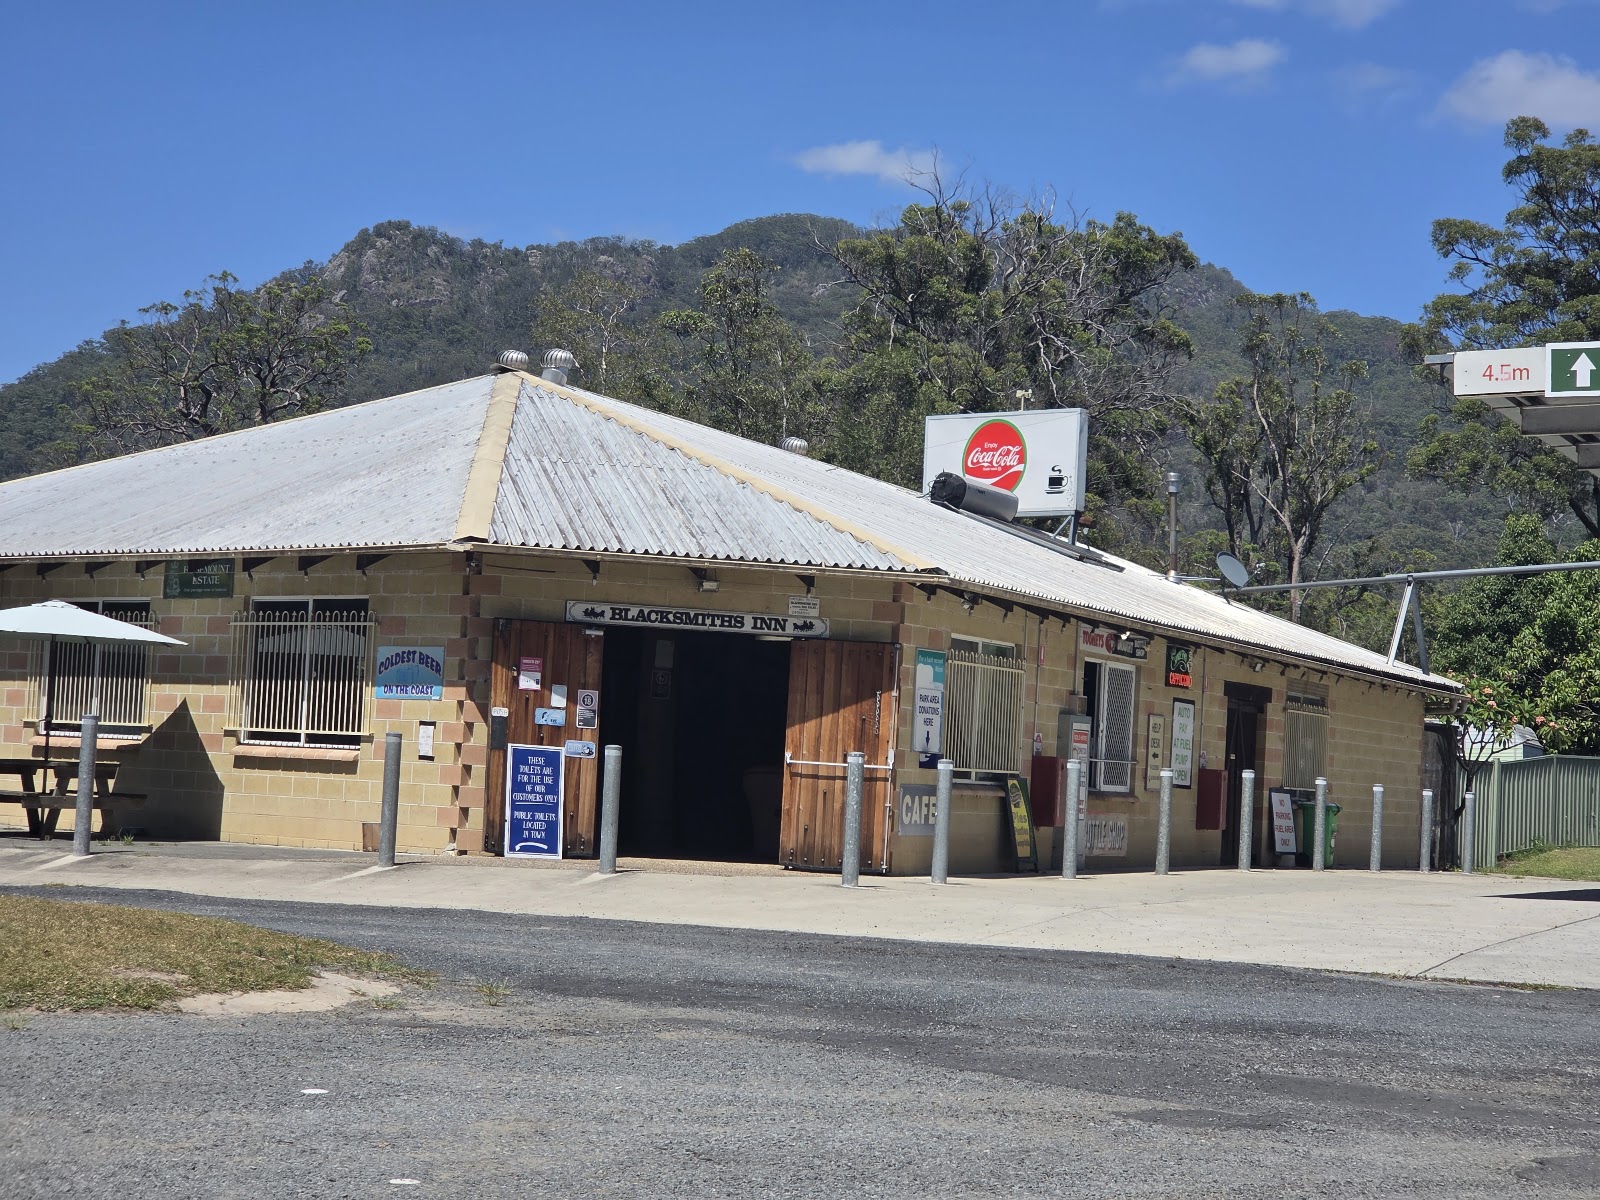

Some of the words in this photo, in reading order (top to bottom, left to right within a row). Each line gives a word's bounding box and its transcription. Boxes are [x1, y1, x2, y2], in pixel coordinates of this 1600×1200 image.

[1482, 364, 1530, 382] 4.5m
[984, 442, 998, 450] Enjoy
[967, 446, 1022, 468] Coca-Cola
[192, 575, 220, 585] ESTATE
[609, 606, 745, 630] BLACKSMITHS
[751, 616, 788, 632] INN
[1135, 648, 1146, 657] SHOP
[378, 650, 417, 675] COLDEST
[418, 651, 442, 676] BEER
[383, 684, 394, 694] ON
[395, 684, 409, 694] THE
[410, 684, 434, 696] COAST
[919, 694, 930, 704] PARK
[930, 695, 940, 704] AREA
[918, 705, 940, 716] DONATIONS
[1178, 707, 1191, 719] AUTO
[923, 717, 934, 727] HERE
[1151, 722, 1161, 734] HELP
[1179, 722, 1188, 734] PAY
[1150, 737, 1161, 749] DESK
[1172, 737, 1180, 749] AT
[1180, 739, 1192, 751] FUEL
[527, 756, 546, 765] THESE
[1175, 753, 1189, 766] PUMP
[519, 765, 541, 775] TOILETS
[542, 767, 554, 775] ARE
[1174, 769, 1188, 781] OPEN
[517, 774, 529, 783] FOR
[530, 775, 542, 784] THE
[543, 776, 554, 785] USE
[525, 784, 533, 792] OF
[534, 785, 546, 793] OUR
[512, 793, 543, 802] CUSTOMERS
[544, 794, 558, 803] ONLY
[1279, 799, 1286, 807] NO
[902, 794, 937, 825] CAFE
[513, 810, 533, 820] PUBLIC
[534, 811, 556, 821] TOILETS
[1275, 811, 1291, 820] PARKING
[522, 820, 547, 830] LOCATED
[1274, 825, 1285, 833] FUEL
[1285, 825, 1295, 834] AREA
[522, 830, 529, 839] IN
[530, 830, 546, 840] TOWN
[1085, 820, 1107, 850] OTTLE
[1107, 820, 1125, 850] SHOP
[1280, 838, 1290, 846] ONLY
